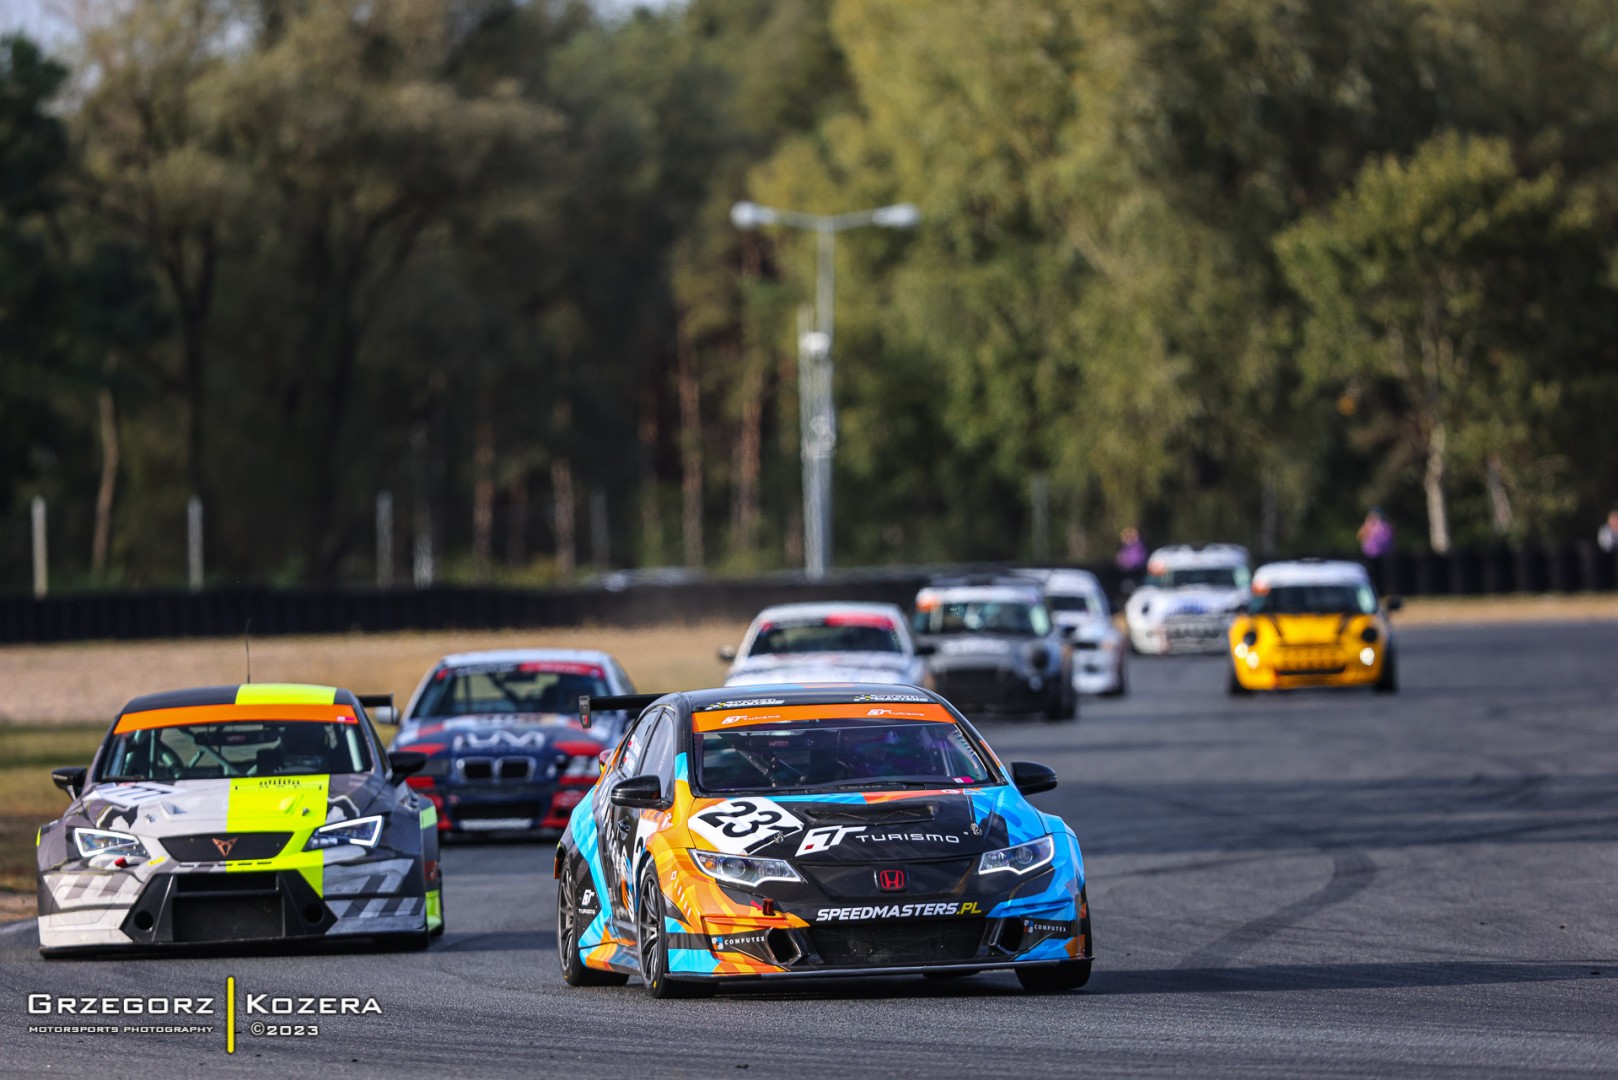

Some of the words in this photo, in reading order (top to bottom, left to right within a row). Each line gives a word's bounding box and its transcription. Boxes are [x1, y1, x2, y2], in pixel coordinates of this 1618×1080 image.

[697, 801, 802, 855] 231
[855, 833, 960, 844] TURISMO
[816, 902, 982, 922] SPEEDMASTERS.PL
[724, 936, 766, 945] COMPUTEX
